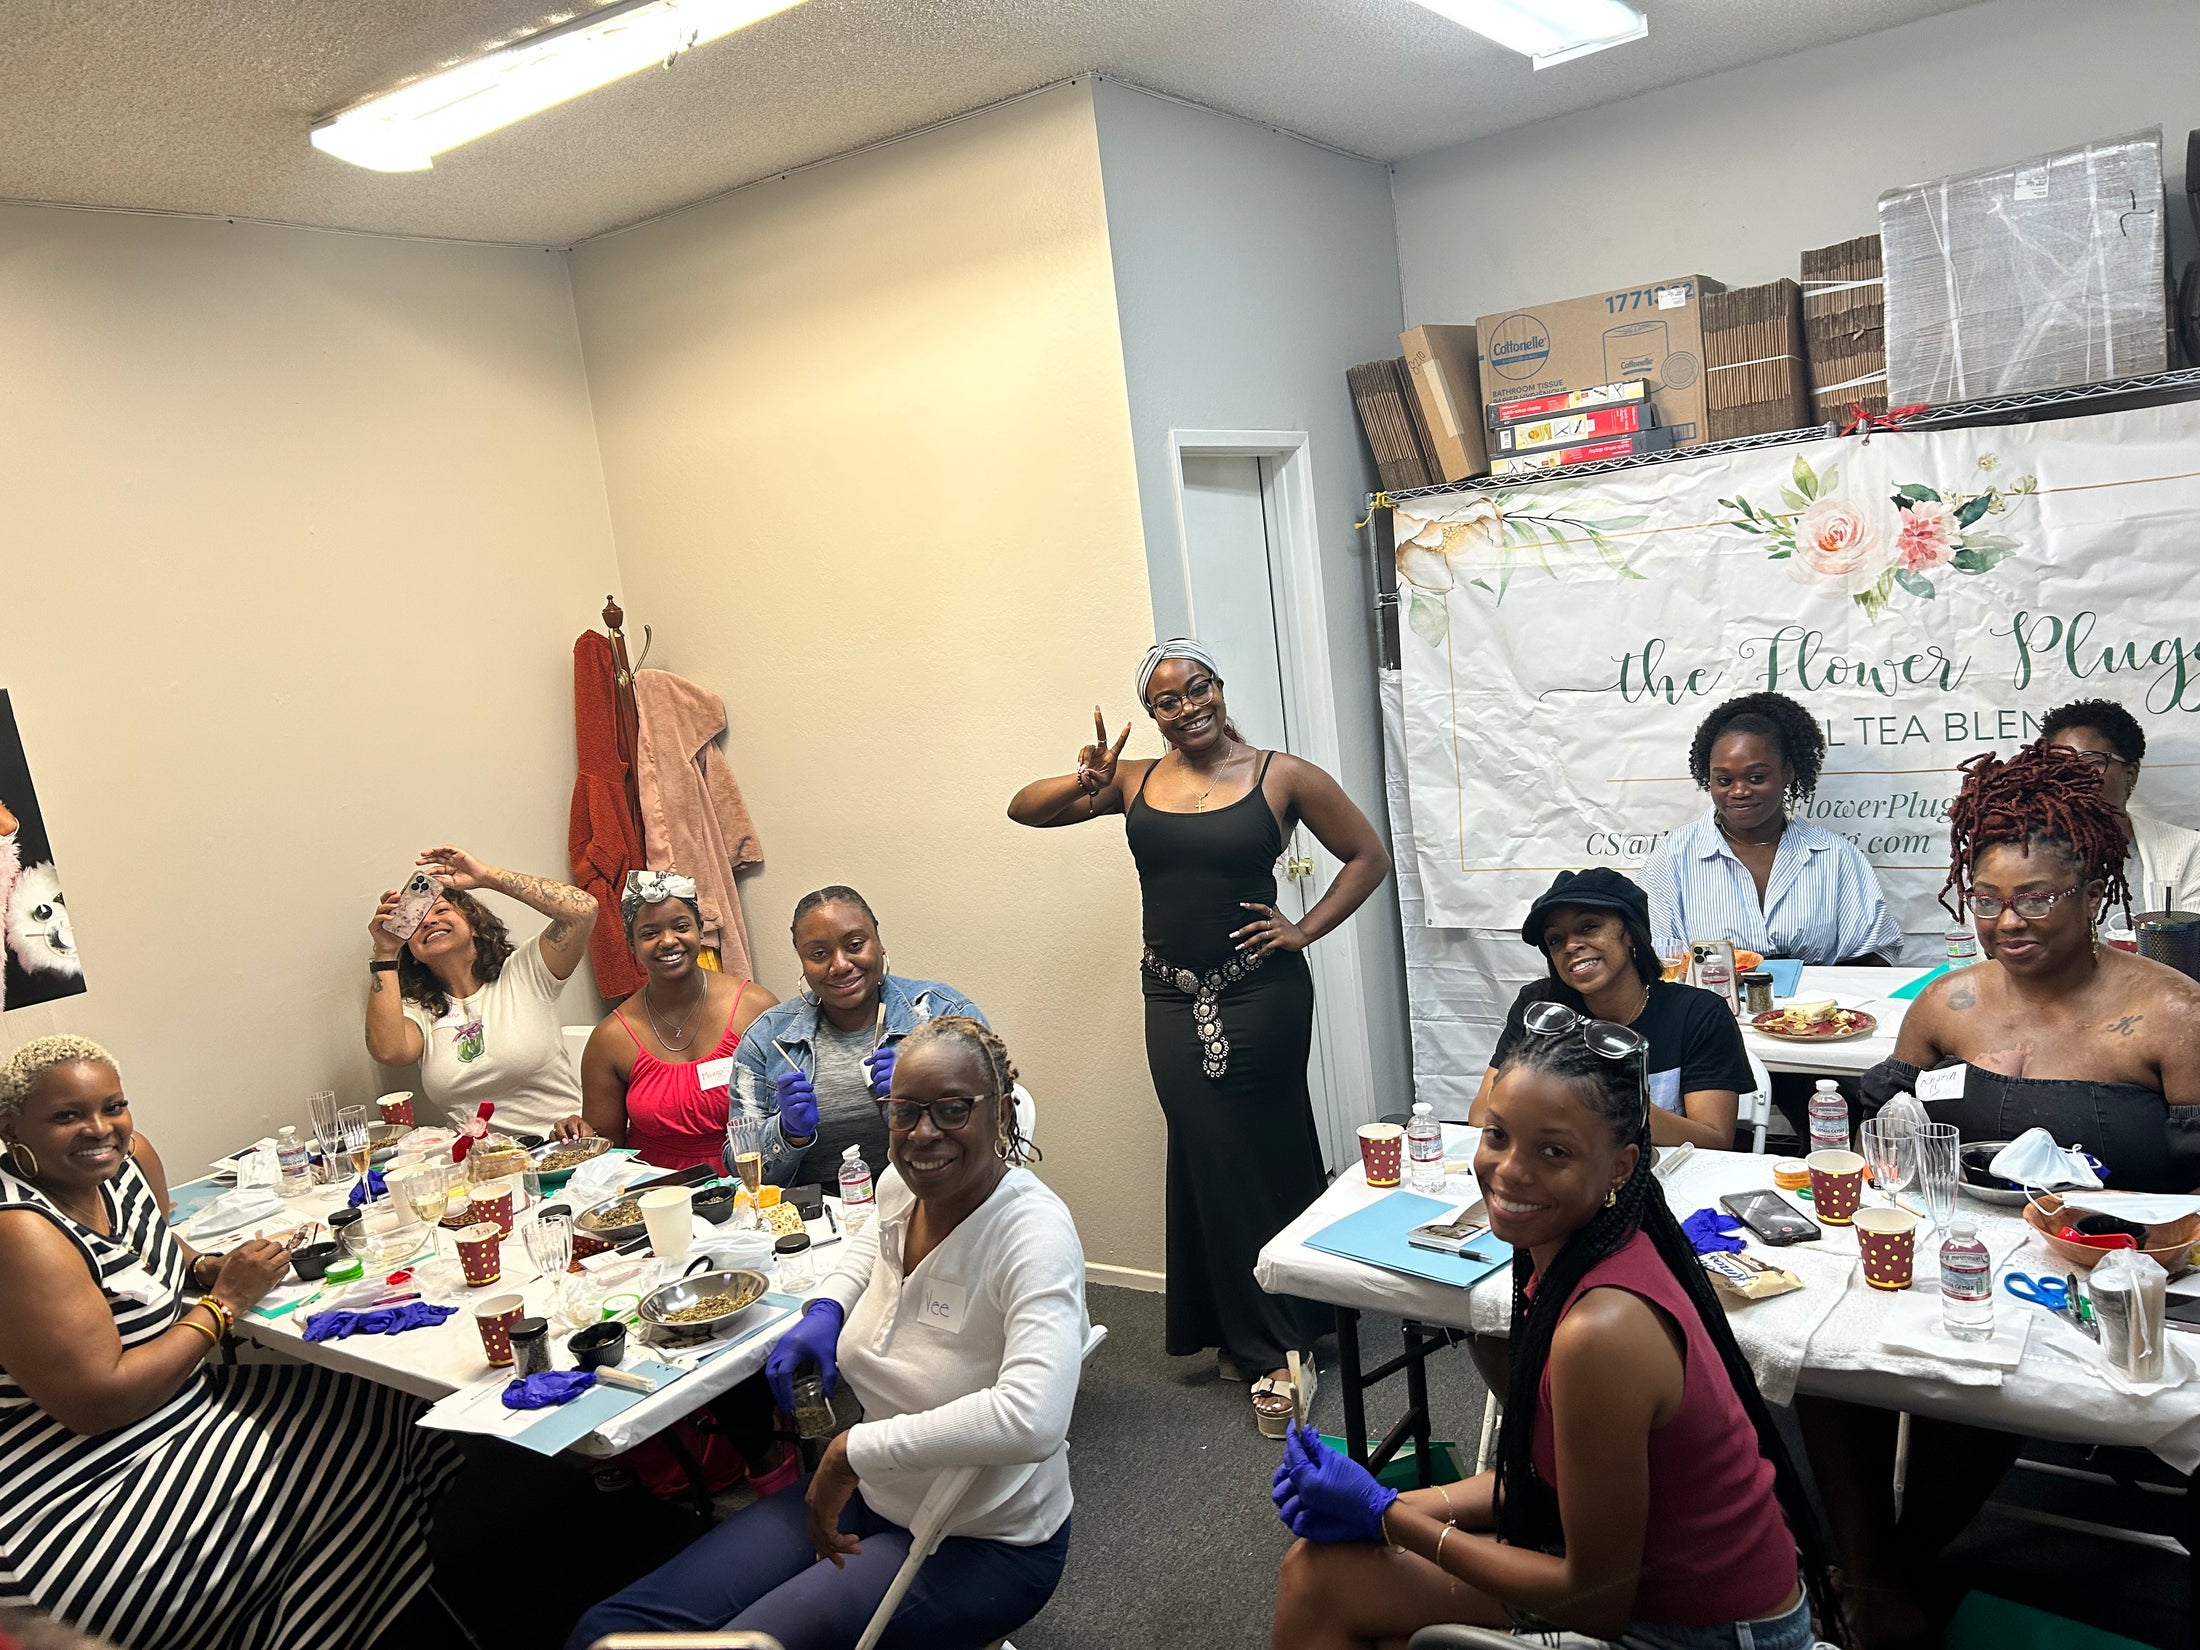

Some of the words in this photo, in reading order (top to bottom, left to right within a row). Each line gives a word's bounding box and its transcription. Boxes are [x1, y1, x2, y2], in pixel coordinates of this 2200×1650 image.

[1493, 336, 1546, 356] Cottonelle
[1492, 384, 1536, 398] BATHROOM
[1537, 379, 1564, 390] TISSUE
[1739, 625, 1972, 698] Flower
[1853, 714, 1930, 746] TEA
[1944, 707, 2050, 743] BLEN
